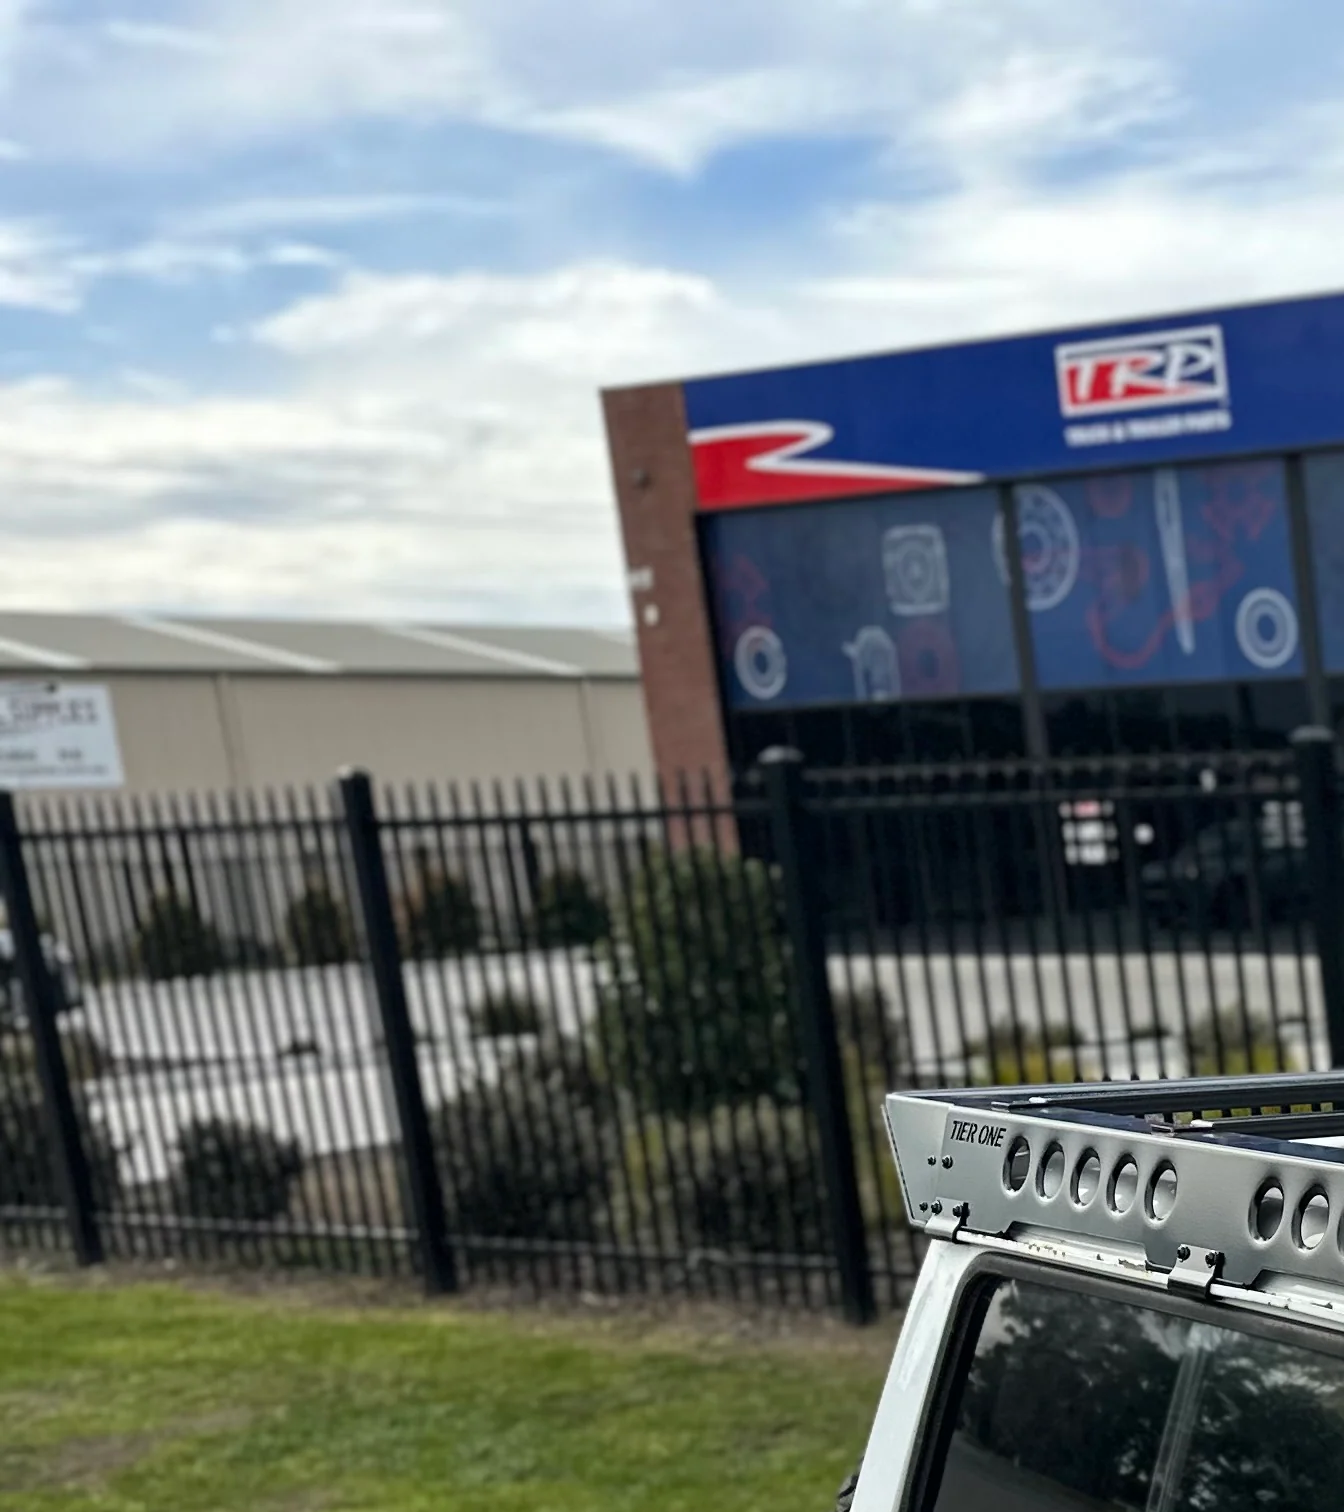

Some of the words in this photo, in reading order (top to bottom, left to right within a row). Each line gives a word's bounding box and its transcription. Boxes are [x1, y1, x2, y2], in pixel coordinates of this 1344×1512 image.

[1064, 341, 1215, 402] TRP
[950, 1120, 978, 1143] TIER
[978, 1124, 1007, 1147] ONE
